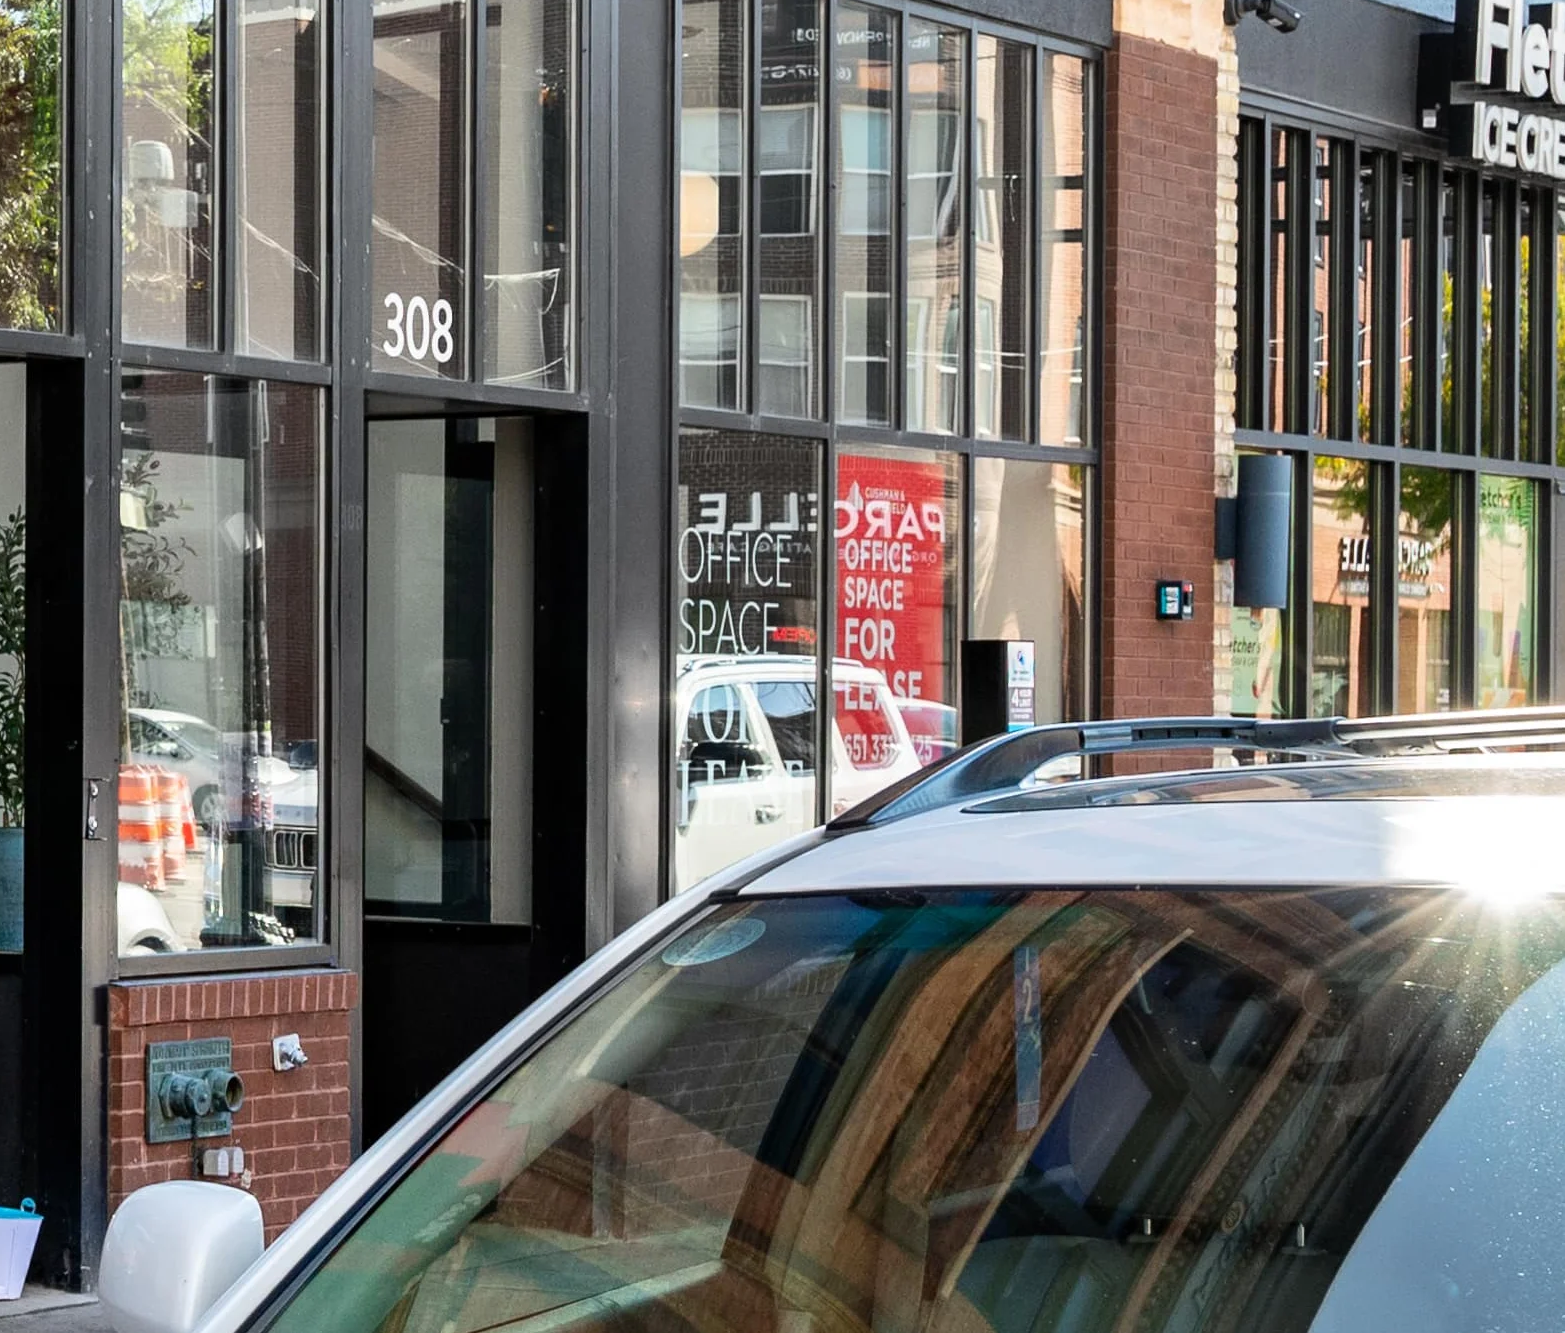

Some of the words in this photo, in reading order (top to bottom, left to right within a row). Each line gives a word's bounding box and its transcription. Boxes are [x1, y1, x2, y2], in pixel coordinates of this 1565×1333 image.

[1472, 100, 1520, 168] ICE
[383, 291, 455, 363] 308
[678, 526, 792, 588] OFFICE
[844, 538, 913, 574] OFFICE
[844, 576, 904, 611] SPACE
[679, 598, 780, 656] SPACE
[844, 618, 896, 661] FOR
